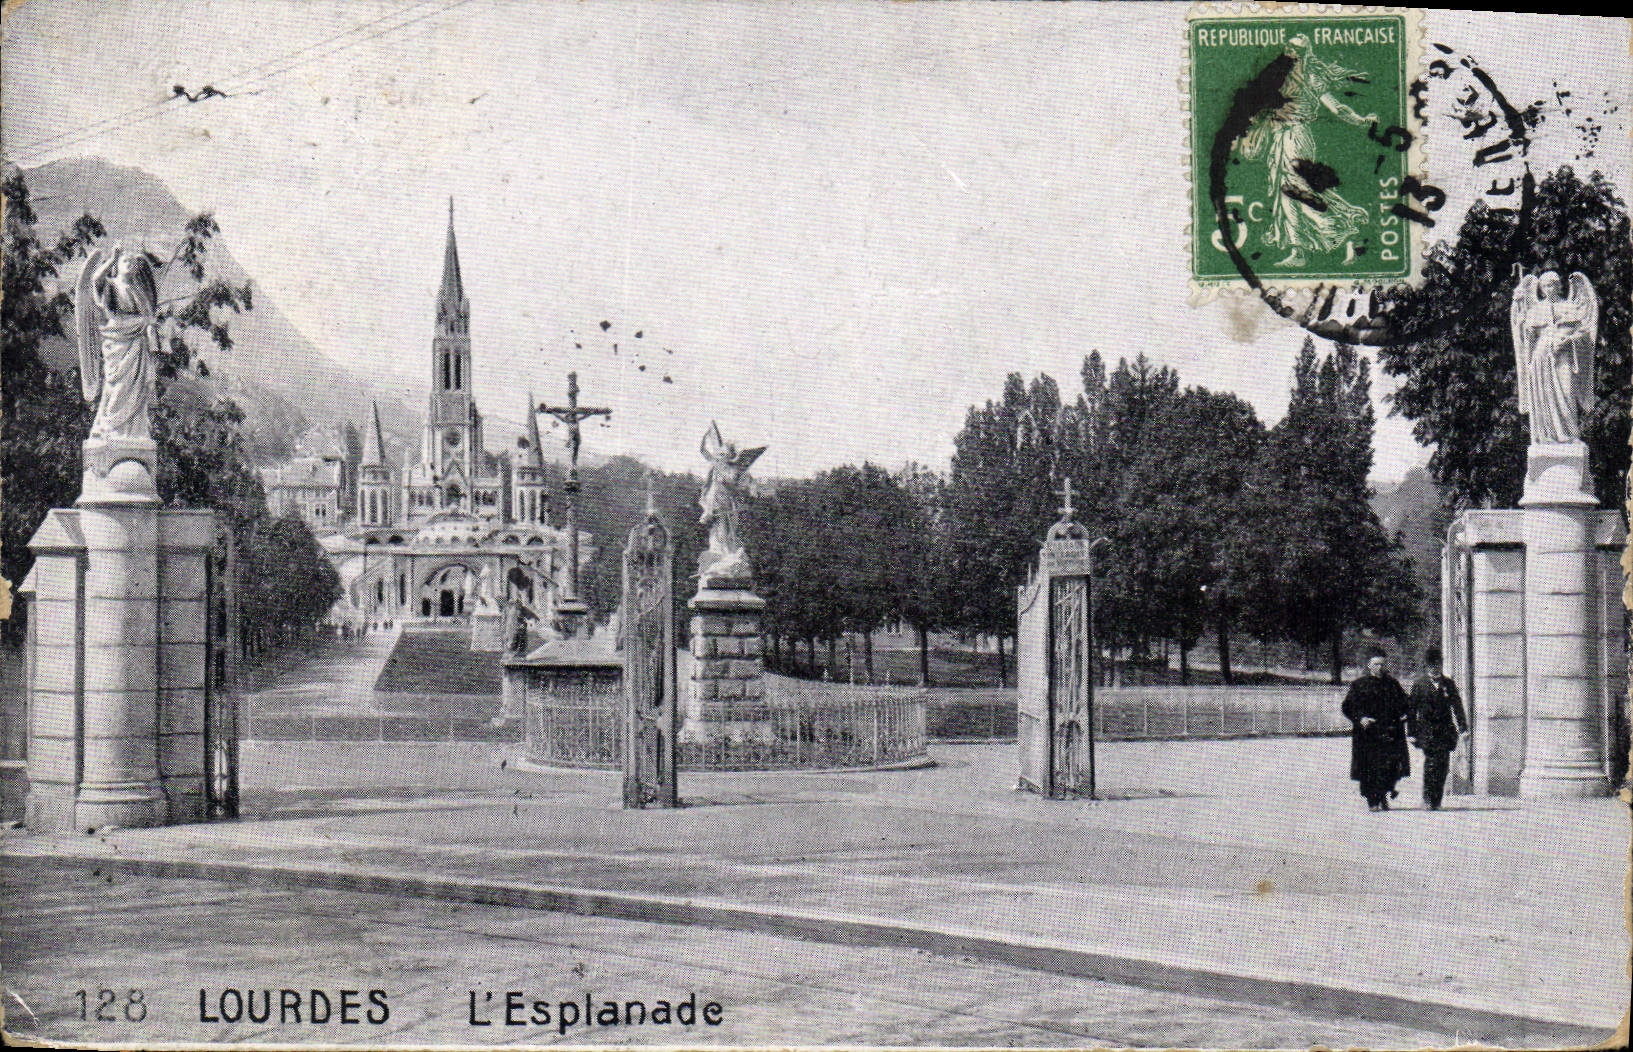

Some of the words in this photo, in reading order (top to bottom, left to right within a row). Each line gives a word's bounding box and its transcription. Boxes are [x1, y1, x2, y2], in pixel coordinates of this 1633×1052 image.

[1198, 28, 1287, 47] REPUBLIQUE
[1314, 27, 1395, 46] FRANÇAISE
[1380, 176, 1399, 261] POSTES
